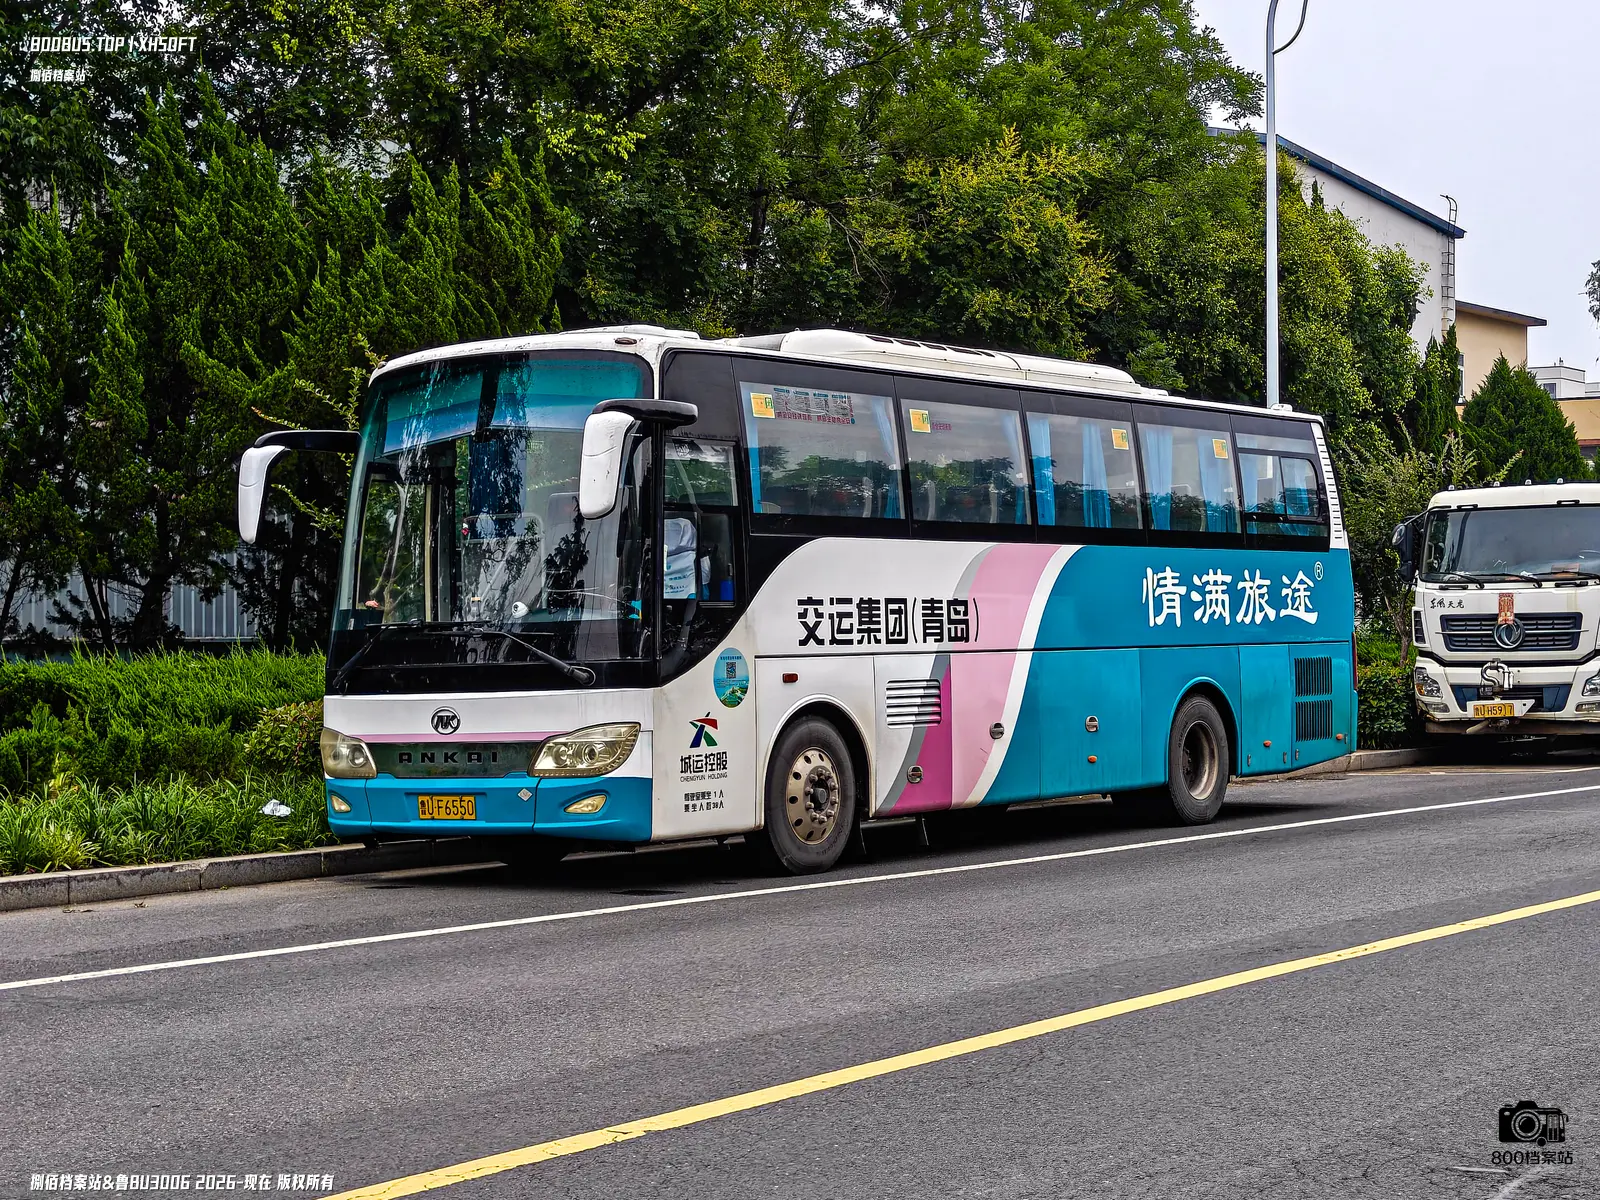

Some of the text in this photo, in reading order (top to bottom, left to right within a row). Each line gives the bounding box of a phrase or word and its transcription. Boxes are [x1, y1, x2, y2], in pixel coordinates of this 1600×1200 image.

[1142, 566, 1319, 628] 情满旅途
[398, 751, 498, 764] ANKAI
[680, 751, 728, 774] 城运控股
[680, 772, 728, 782] CHENGYUN HOLDING
